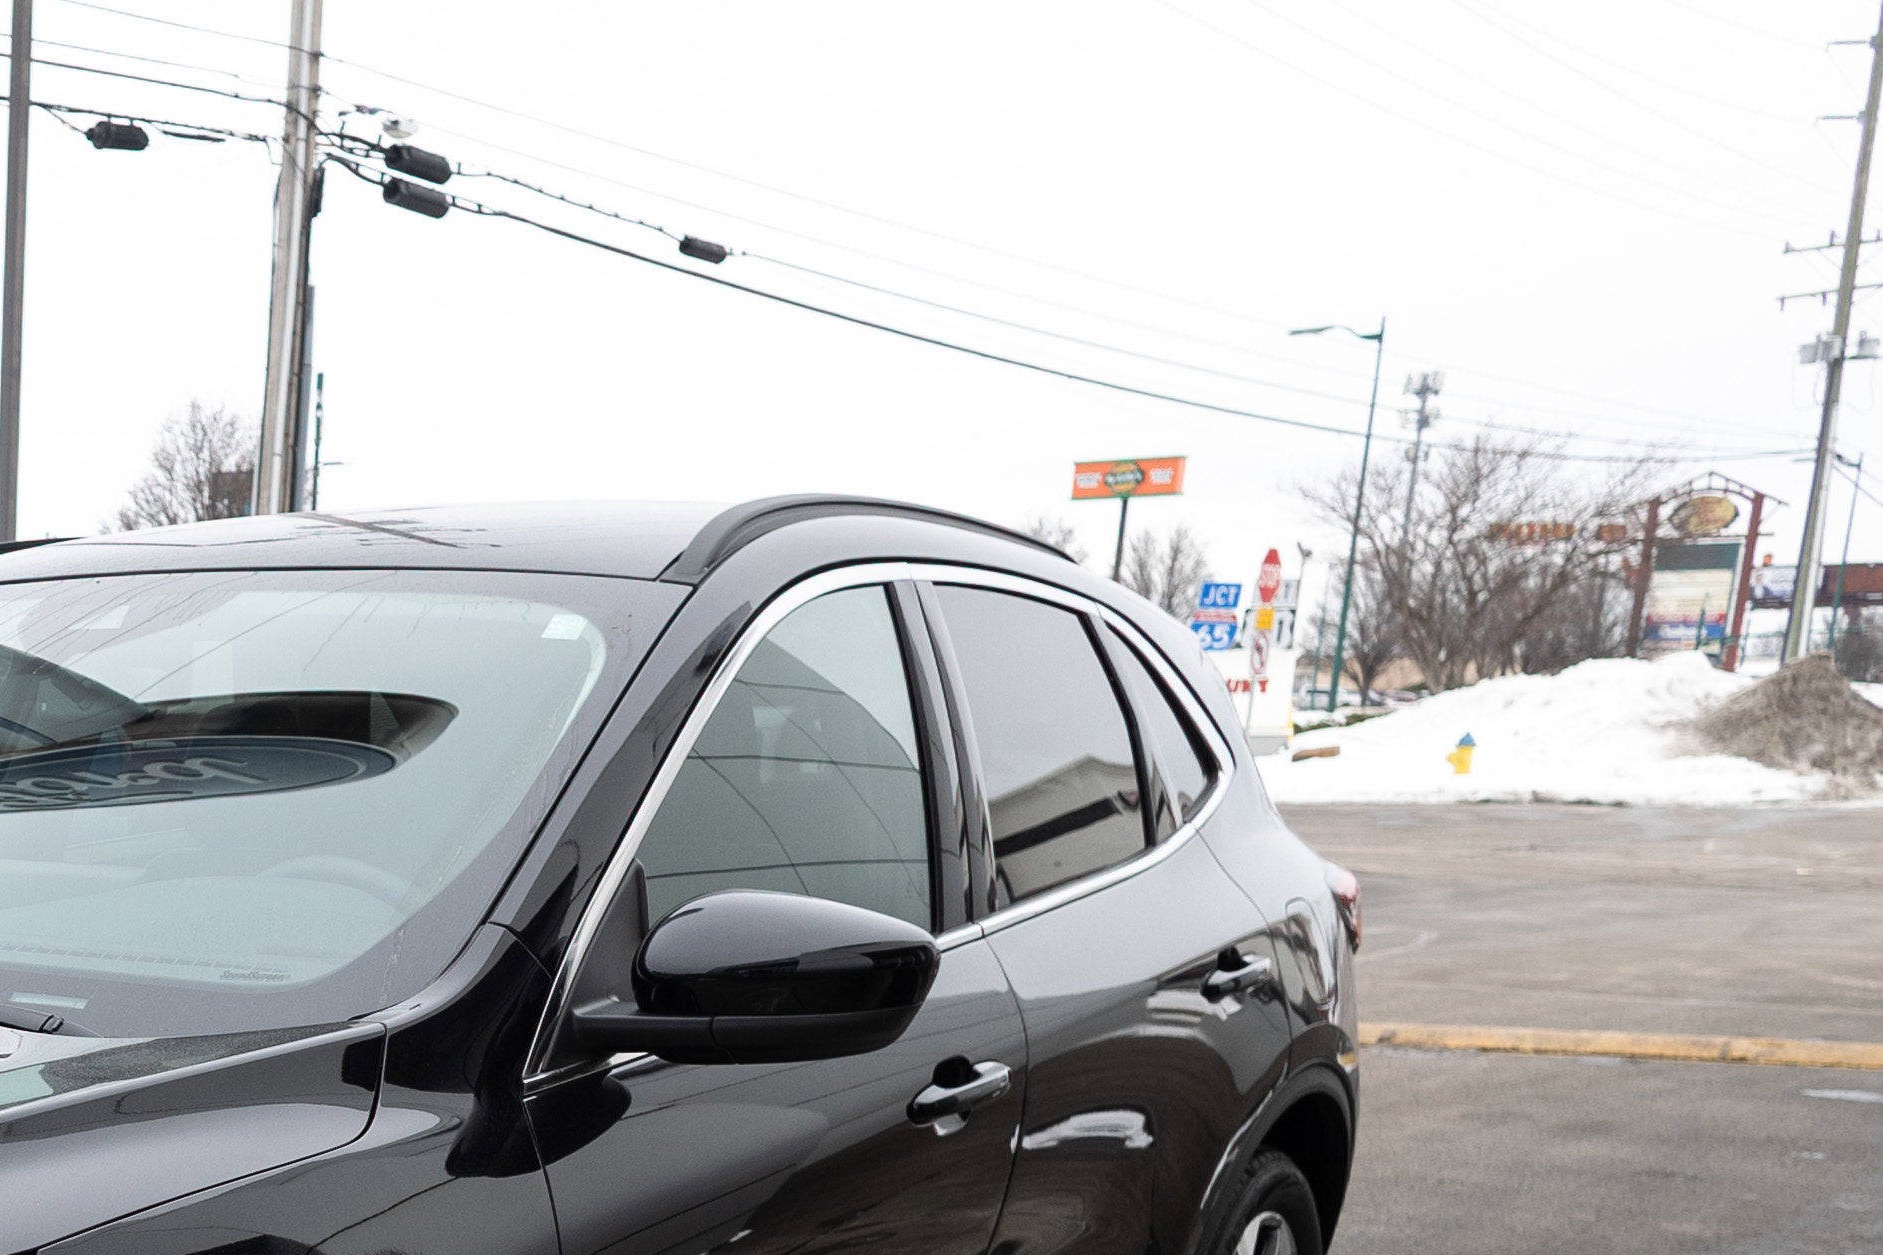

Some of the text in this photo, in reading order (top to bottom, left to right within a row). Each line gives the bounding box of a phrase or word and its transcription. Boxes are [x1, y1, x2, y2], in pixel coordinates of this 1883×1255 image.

[1258, 563, 1281, 589] STOP
[1203, 584, 1238, 606] JCT
[1198, 623, 1230, 649] 65
